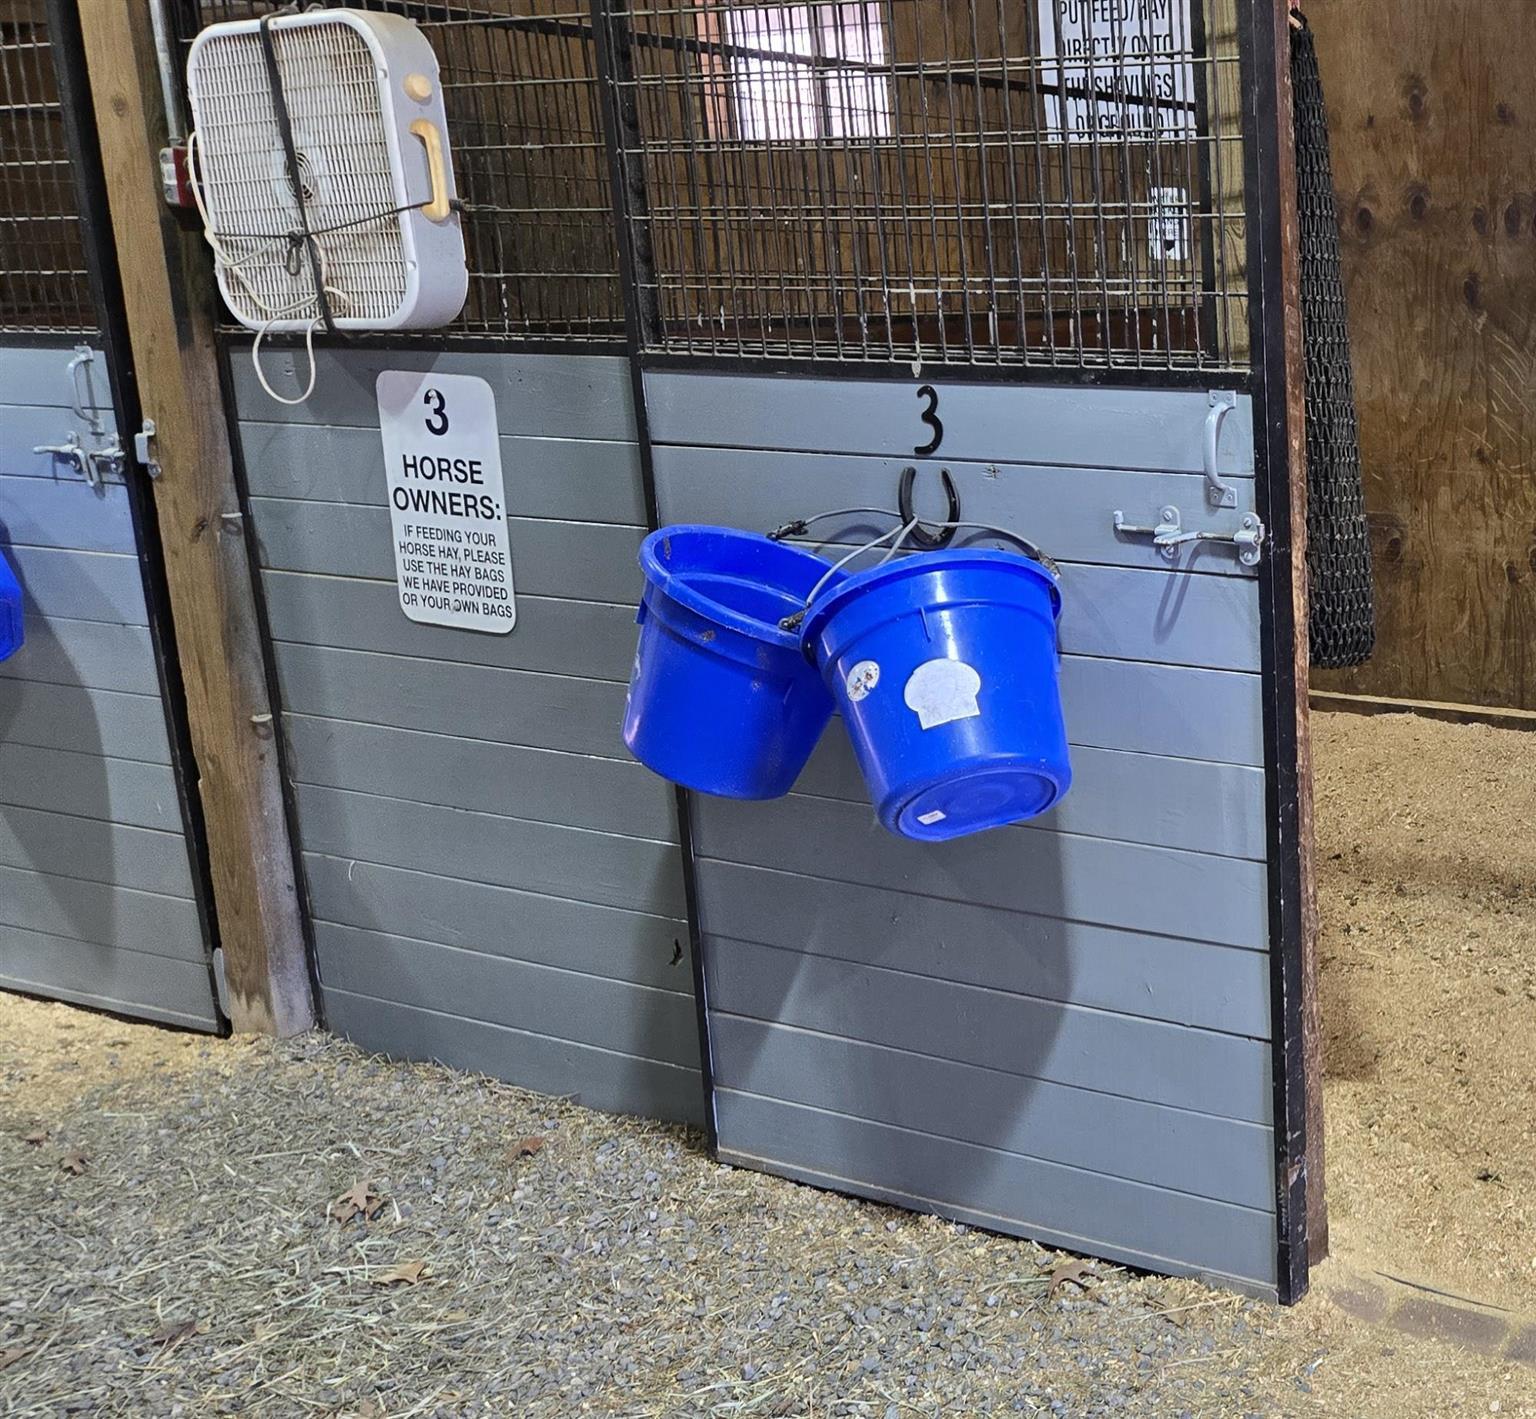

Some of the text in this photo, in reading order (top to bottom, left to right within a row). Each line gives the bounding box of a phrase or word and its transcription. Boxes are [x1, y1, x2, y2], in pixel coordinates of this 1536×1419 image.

[1059, 36, 1127, 62] DIRECTY
[1062, 77, 1089, 101] TH
[423, 388, 449, 436] 3
[915, 385, 943, 454] 3
[403, 455, 484, 484] HORSE
[393, 487, 501, 520] OWNERS:
[404, 525, 496, 546] IF FEEDING YOUR
[399, 541, 505, 565] HORSE HAY, PLEASE
[403, 559, 504, 582] USE THE HAY BAGS
[403, 576, 508, 600] WE HAVE PROVIDED
[403, 593, 512, 618] OR YOUR OWN BAGS
